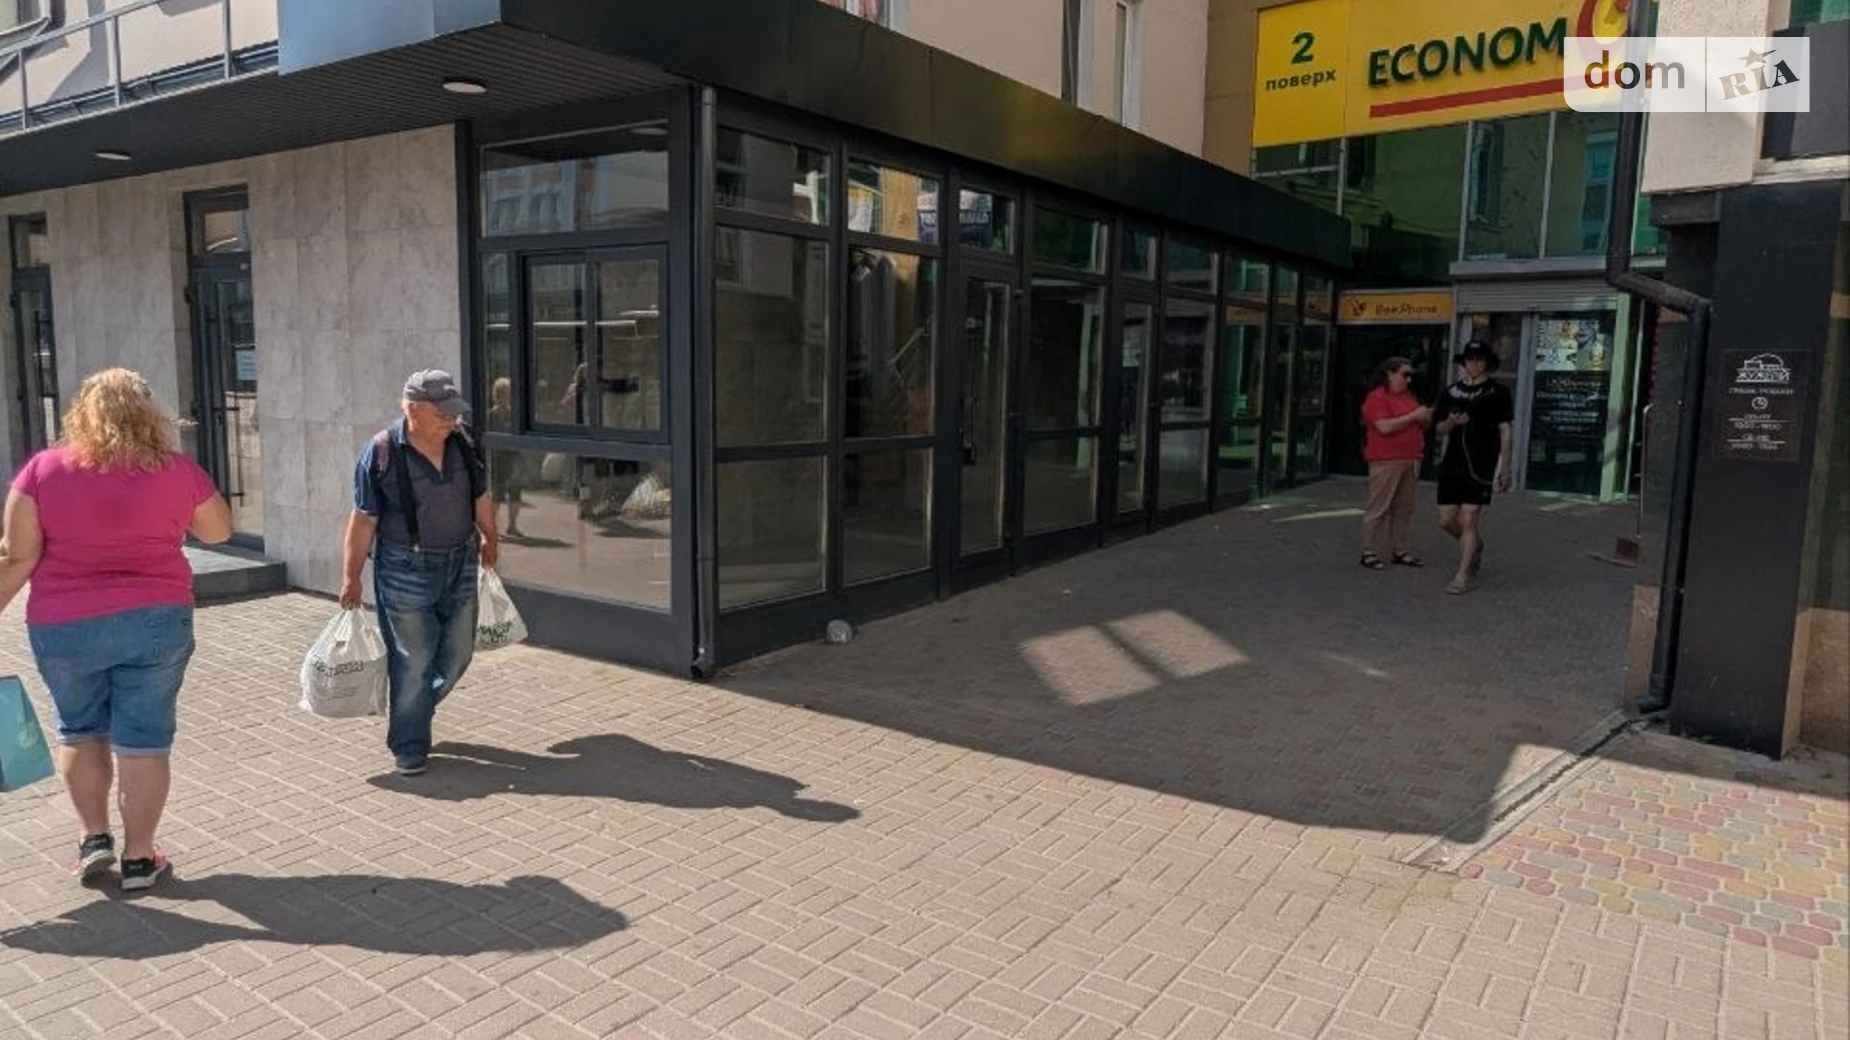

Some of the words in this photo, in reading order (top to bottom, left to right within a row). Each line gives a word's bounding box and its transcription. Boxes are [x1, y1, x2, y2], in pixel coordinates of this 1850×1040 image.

[1291, 32, 1316, 65] 2
[1368, 17, 1567, 87] ECONOM
[1265, 70, 1337, 91] поверх
